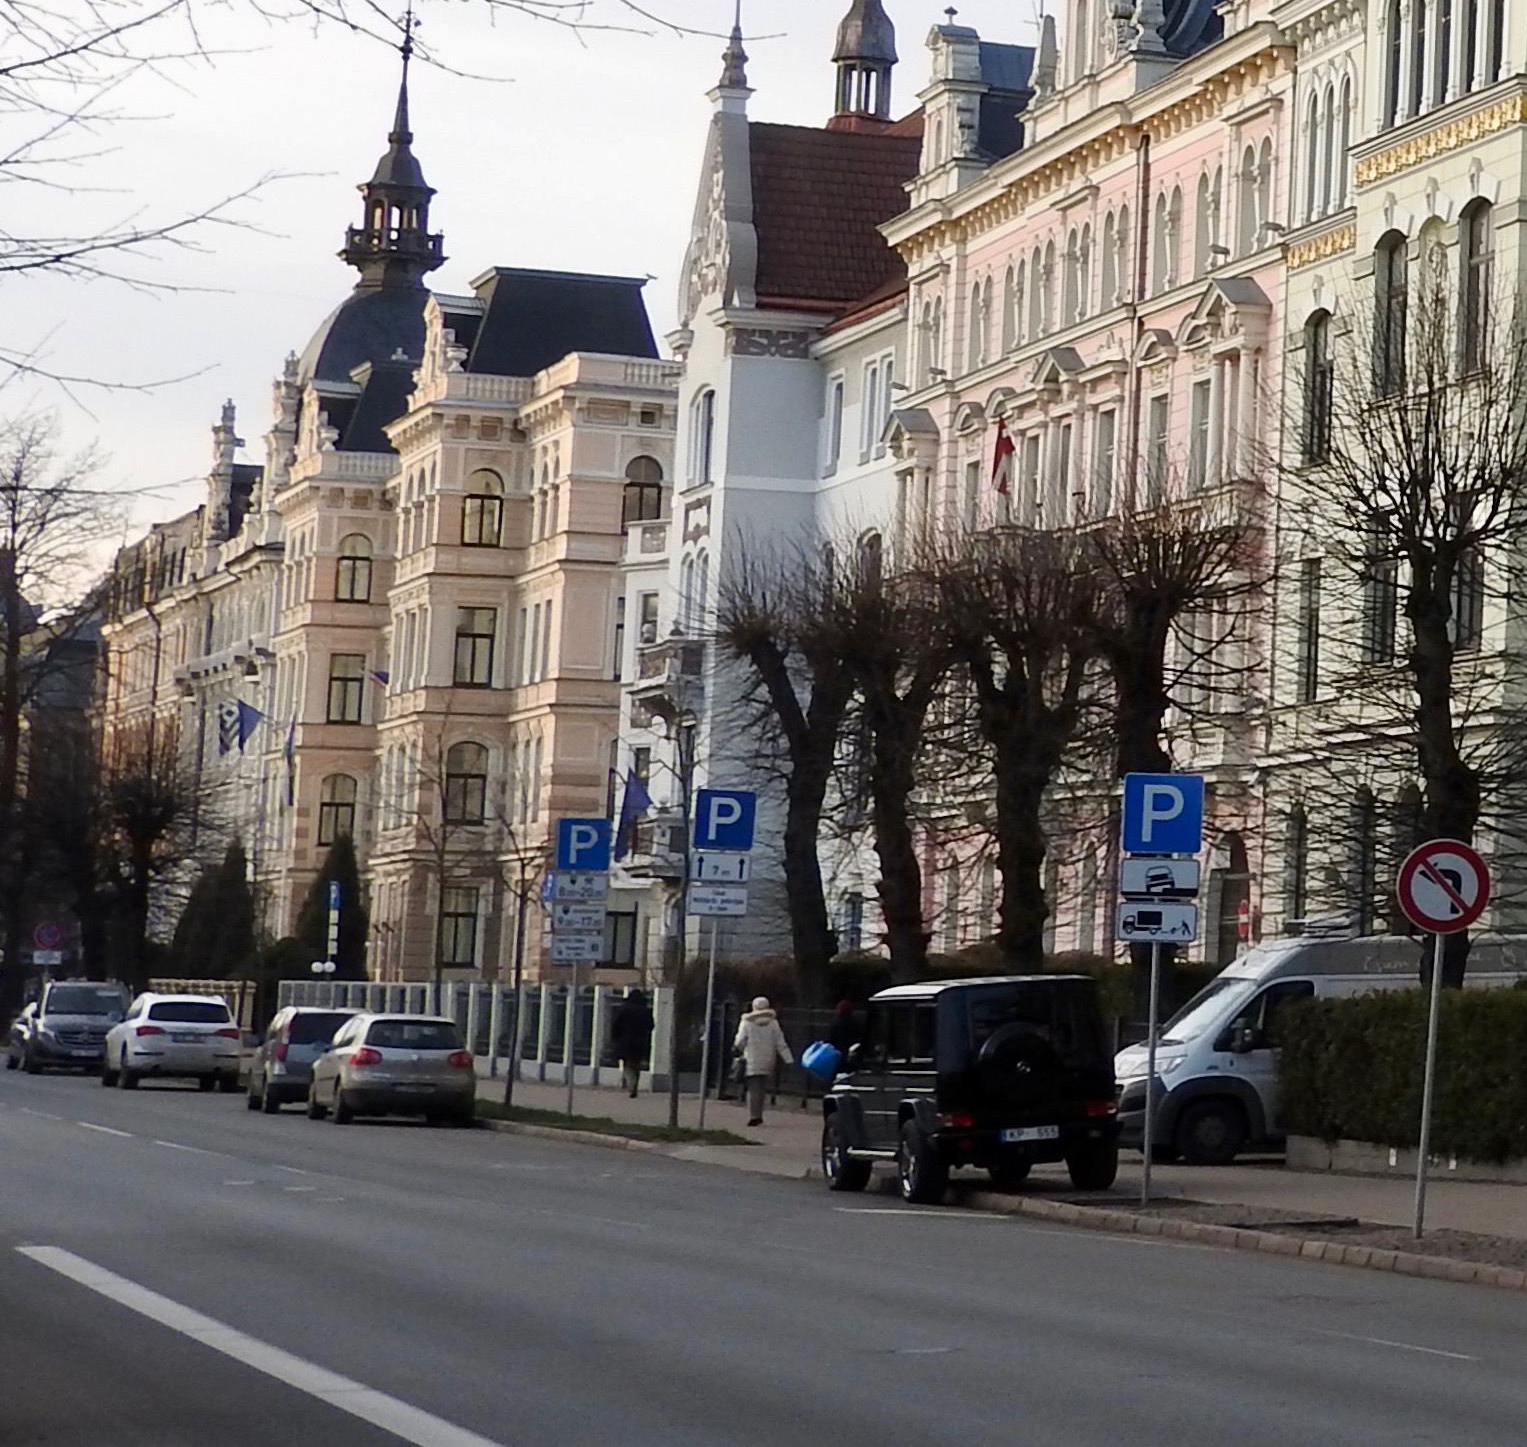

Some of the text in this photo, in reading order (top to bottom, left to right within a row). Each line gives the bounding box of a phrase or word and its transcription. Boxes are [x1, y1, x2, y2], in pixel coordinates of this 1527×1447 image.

[708, 797, 742, 841] P
[1141, 784, 1185, 843] P
[569, 825, 599, 864] P
